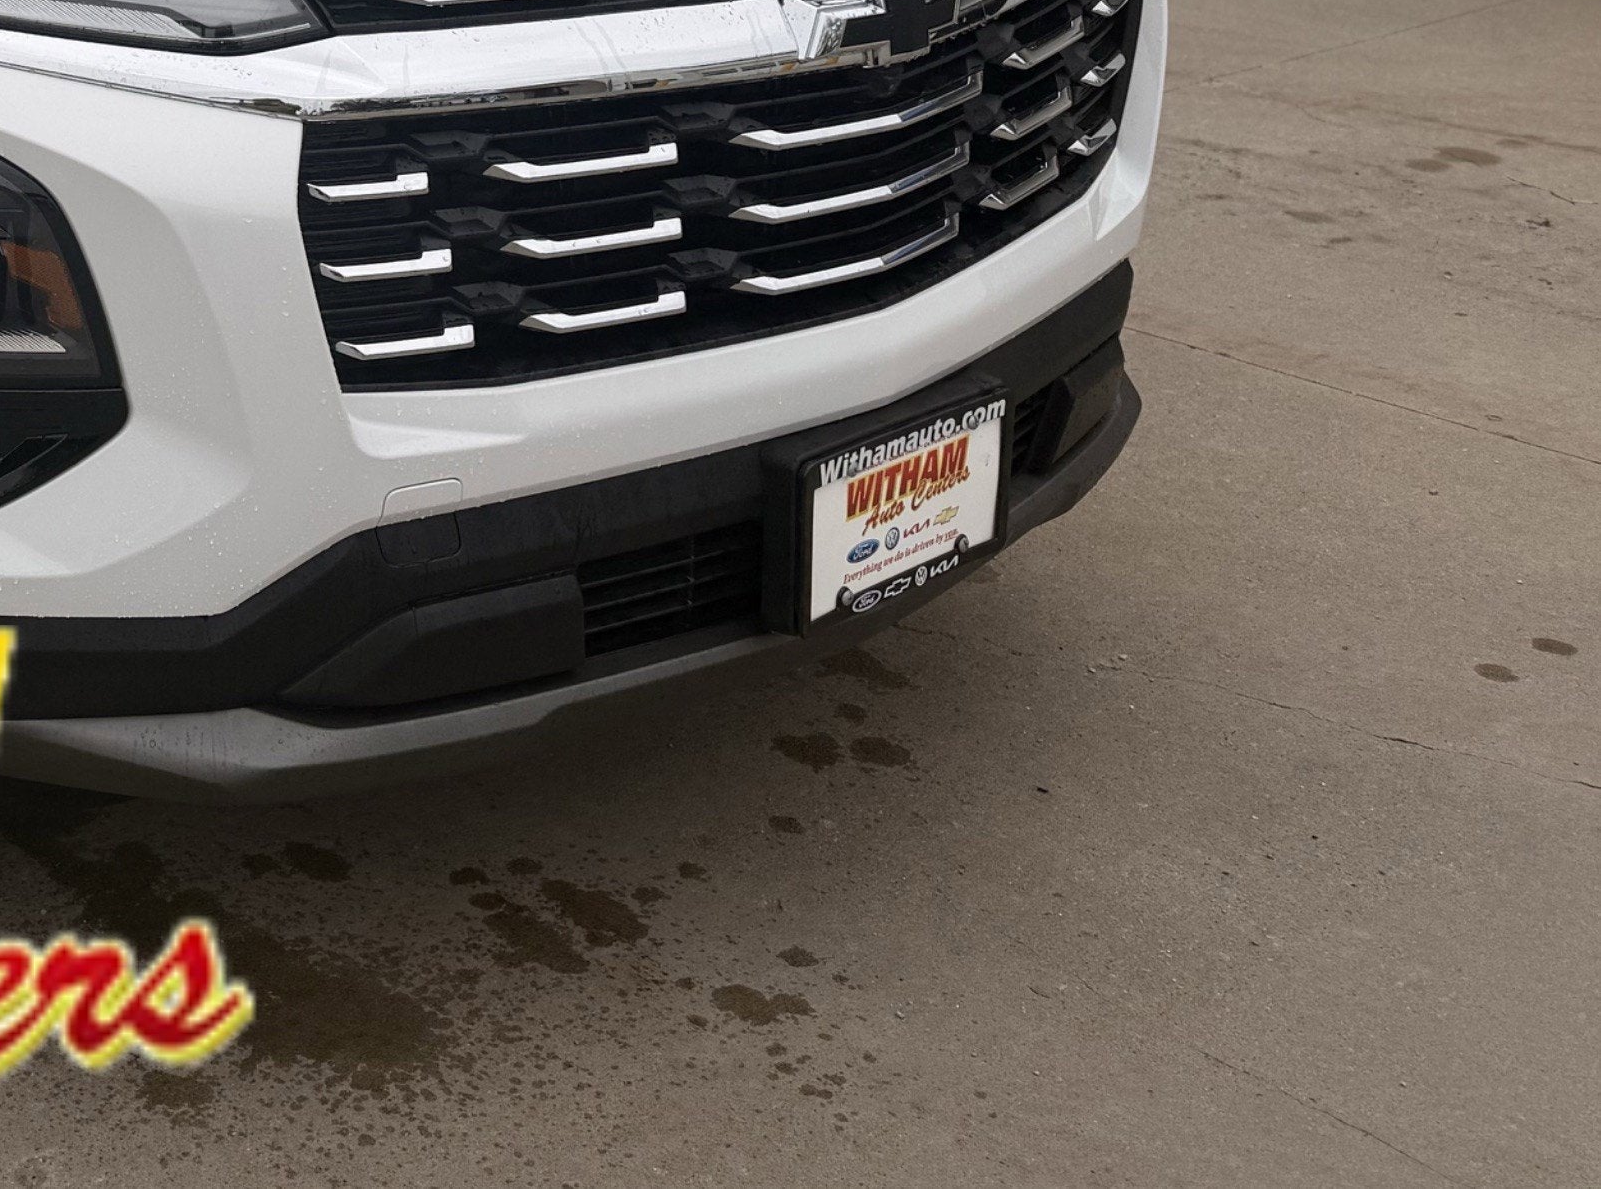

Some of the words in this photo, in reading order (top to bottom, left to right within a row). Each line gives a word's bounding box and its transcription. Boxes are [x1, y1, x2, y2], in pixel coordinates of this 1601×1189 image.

[820, 398, 1006, 486] Withamauto.com
[846, 434, 970, 522] WITHAM
[862, 500, 905, 536] Auto
[911, 464, 970, 511] Centers
[843, 561, 883, 584] Everything
[895, 550, 905, 561] do
[912, 537, 934, 554] driven
[936, 533, 943, 544] by
